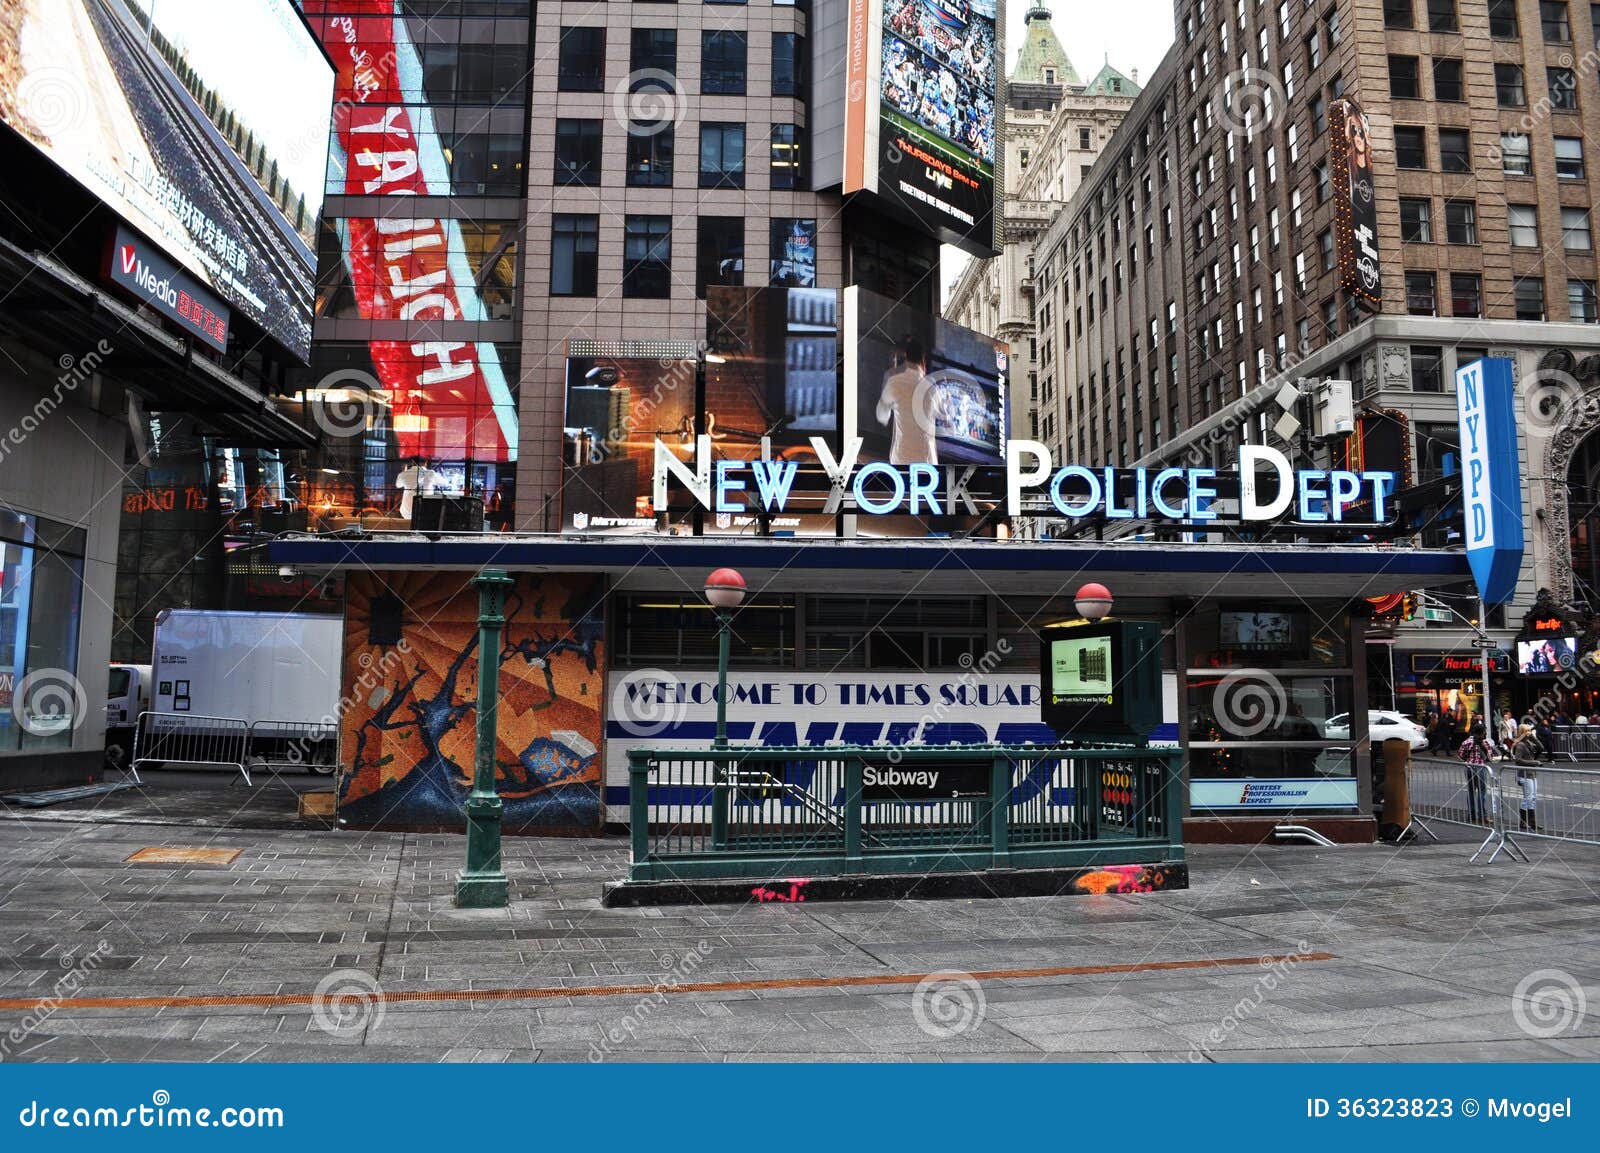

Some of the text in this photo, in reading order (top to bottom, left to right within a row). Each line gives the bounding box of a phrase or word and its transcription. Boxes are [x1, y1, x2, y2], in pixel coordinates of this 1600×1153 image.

[853, 15, 863, 72] THOMSON
[896, 138, 952, 175] THURSDAYS
[925, 166, 953, 190] LIVE
[1463, 370, 1486, 542] NYPD
[653, 434, 1394, 522] NEW YORK POLICE DEPT
[590, 516, 658, 526] NETWORK
[733, 516, 801, 526] NEORK
[1445, 657, 1471, 669] Hard
[624, 682, 1041, 707] WELCOME TO TIMES SQUAR
[862, 767, 939, 789] Subway
